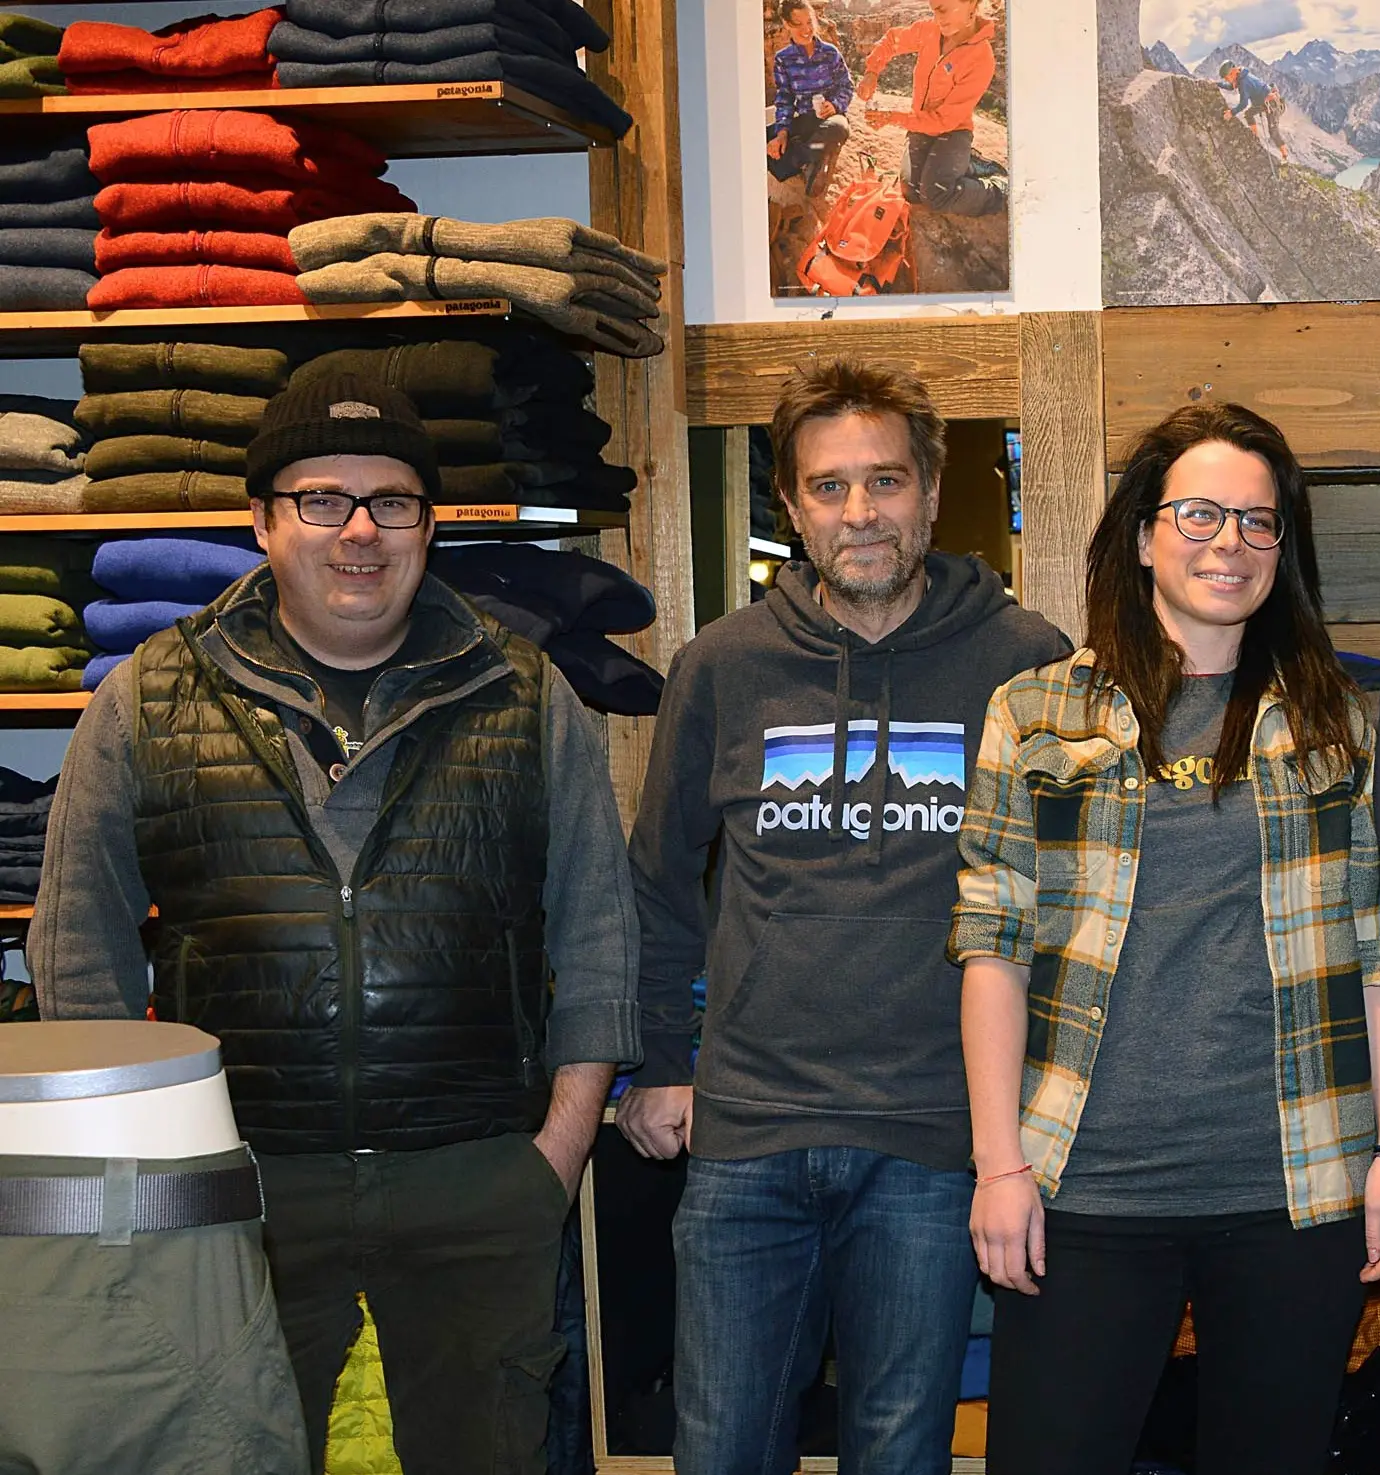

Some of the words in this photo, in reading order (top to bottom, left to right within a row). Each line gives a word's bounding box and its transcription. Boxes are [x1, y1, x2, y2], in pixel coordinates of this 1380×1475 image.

[437, 84, 493, 97] patagonia
[445, 299, 501, 313] patagonia
[456, 507, 511, 518] patagonia
